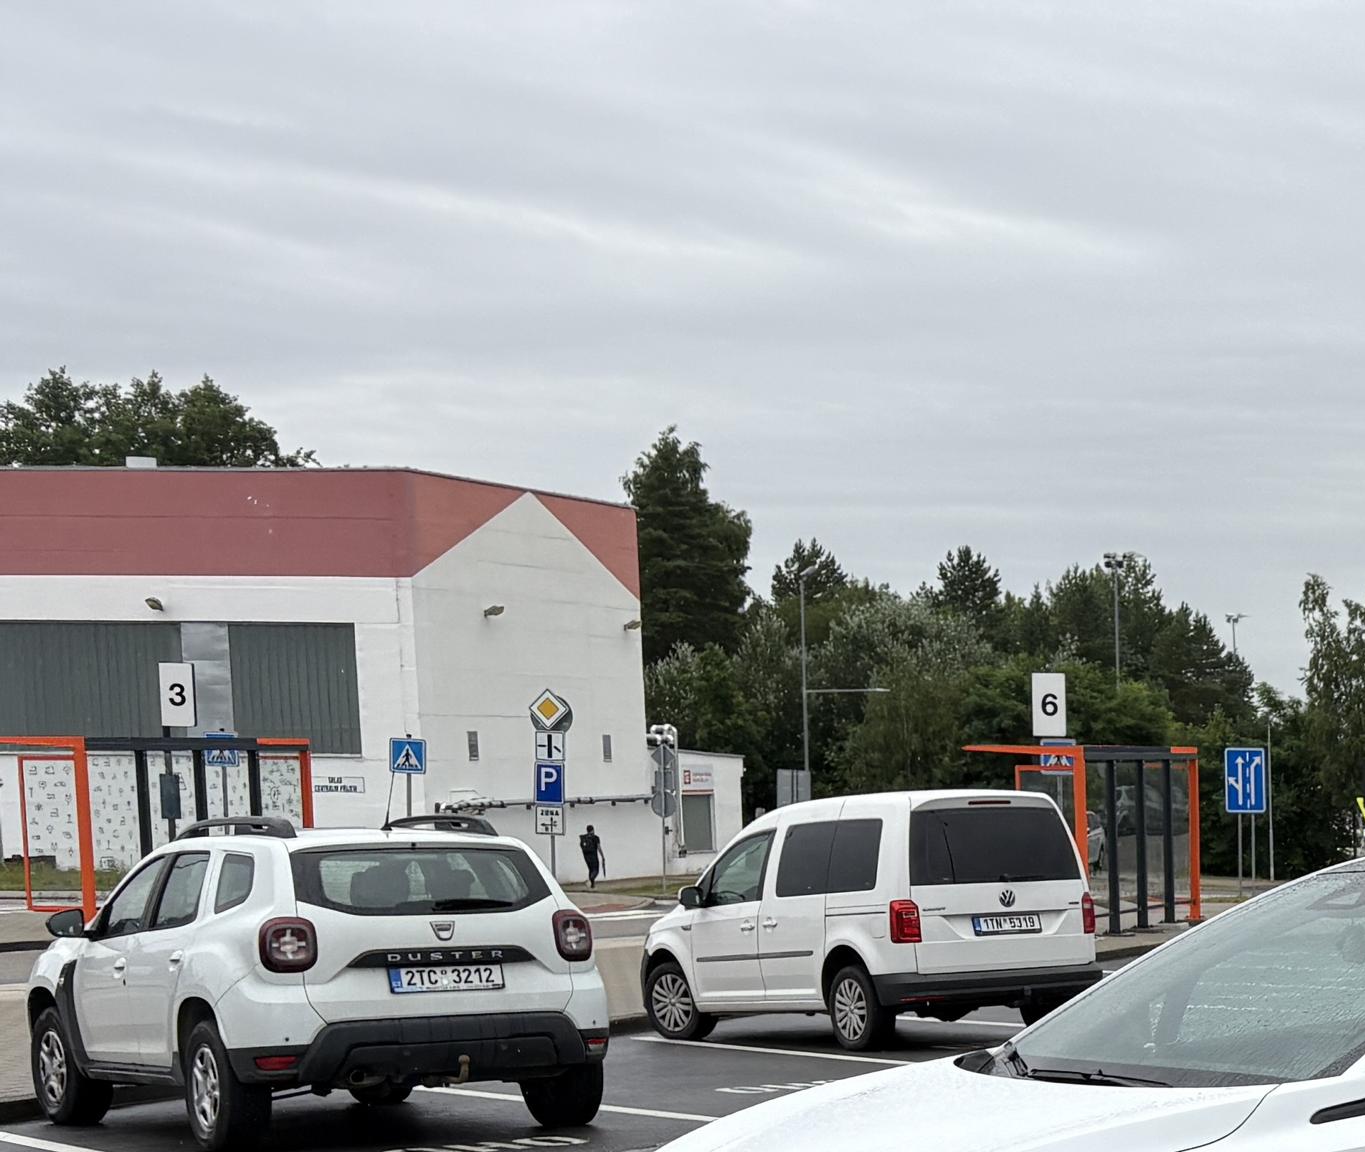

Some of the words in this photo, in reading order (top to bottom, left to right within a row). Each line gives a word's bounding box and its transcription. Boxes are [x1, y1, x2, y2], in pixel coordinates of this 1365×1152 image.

[168, 682, 187, 707] 3
[1041, 693, 1059, 717] 6
[540, 767, 558, 792] P
[387, 950, 504, 962] DUSTER
[405, 969, 439, 986] 2TC
[451, 967, 495, 984] 3212
